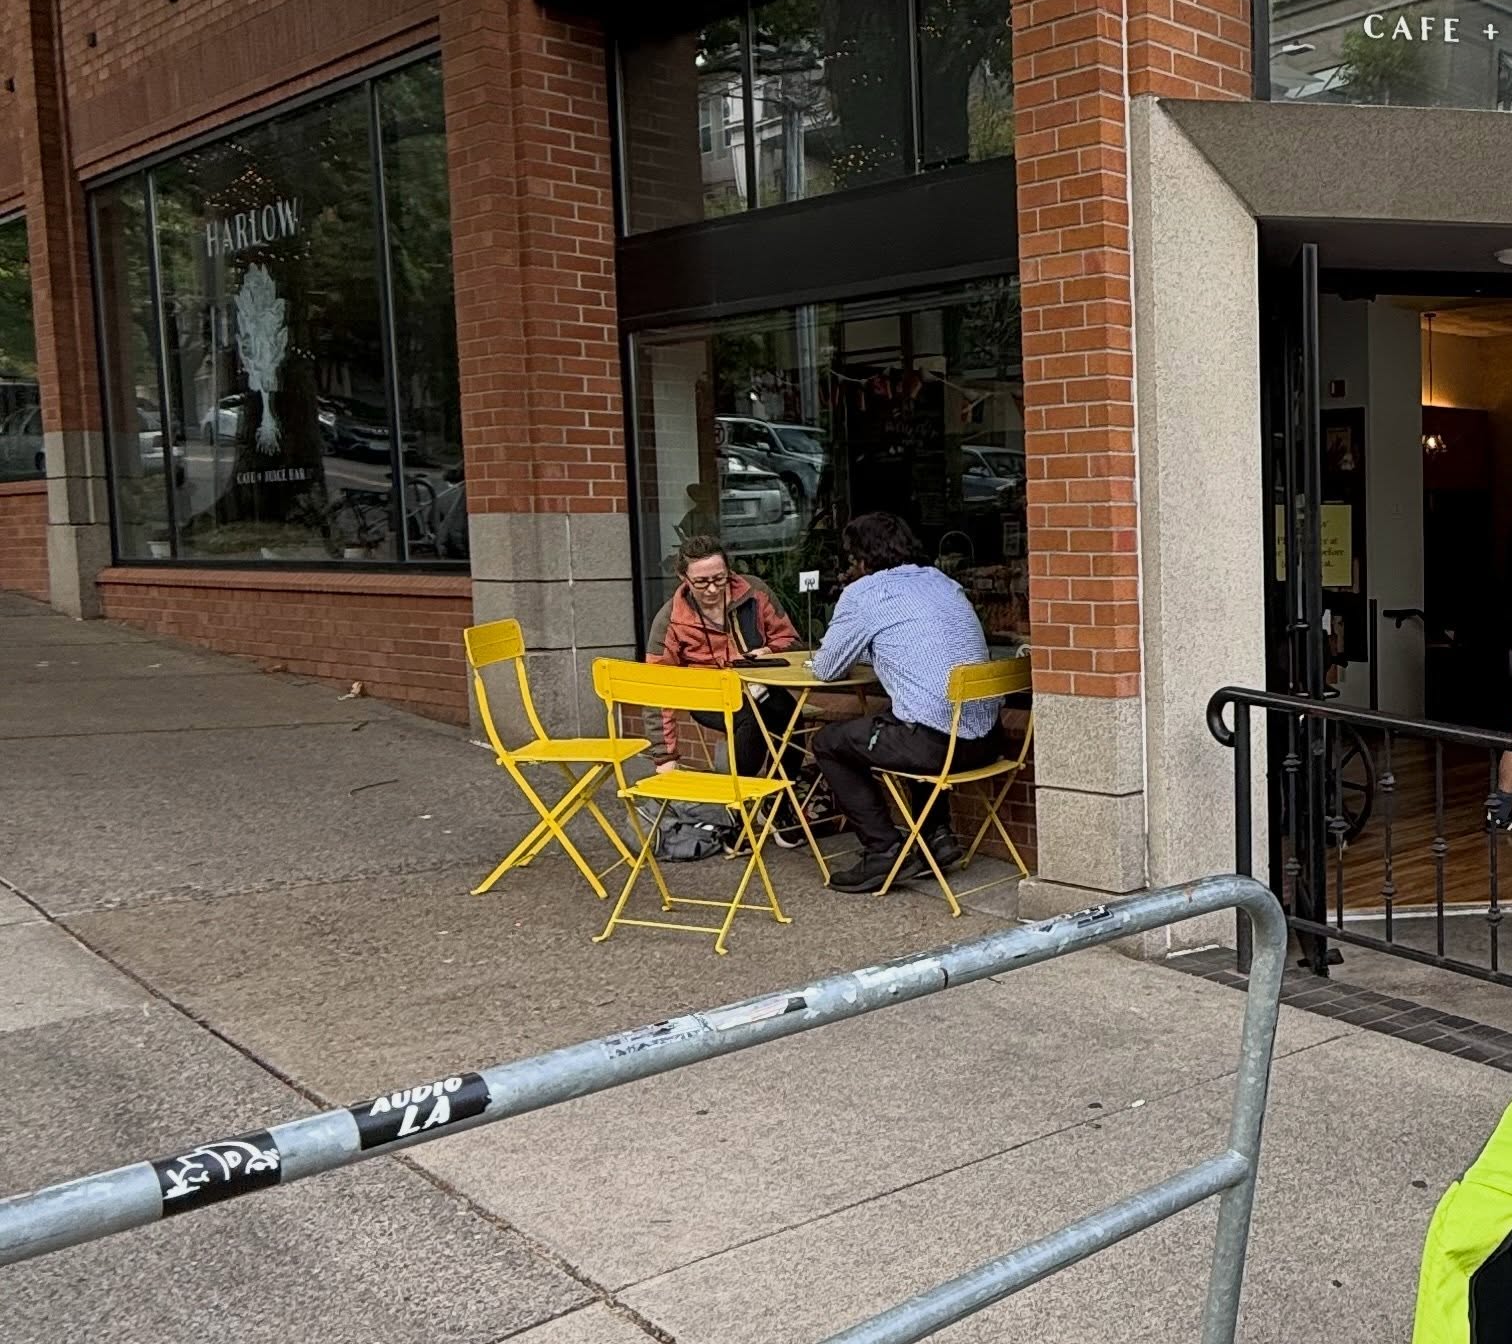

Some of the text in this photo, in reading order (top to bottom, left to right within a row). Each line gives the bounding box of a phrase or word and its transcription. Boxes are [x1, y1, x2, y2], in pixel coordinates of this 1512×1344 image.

[1363, 13, 1461, 43] CAFE
[206, 195, 298, 257] HARLOW
[369, 1077, 463, 1116] AUDIO
[397, 1095, 451, 1136] LA
